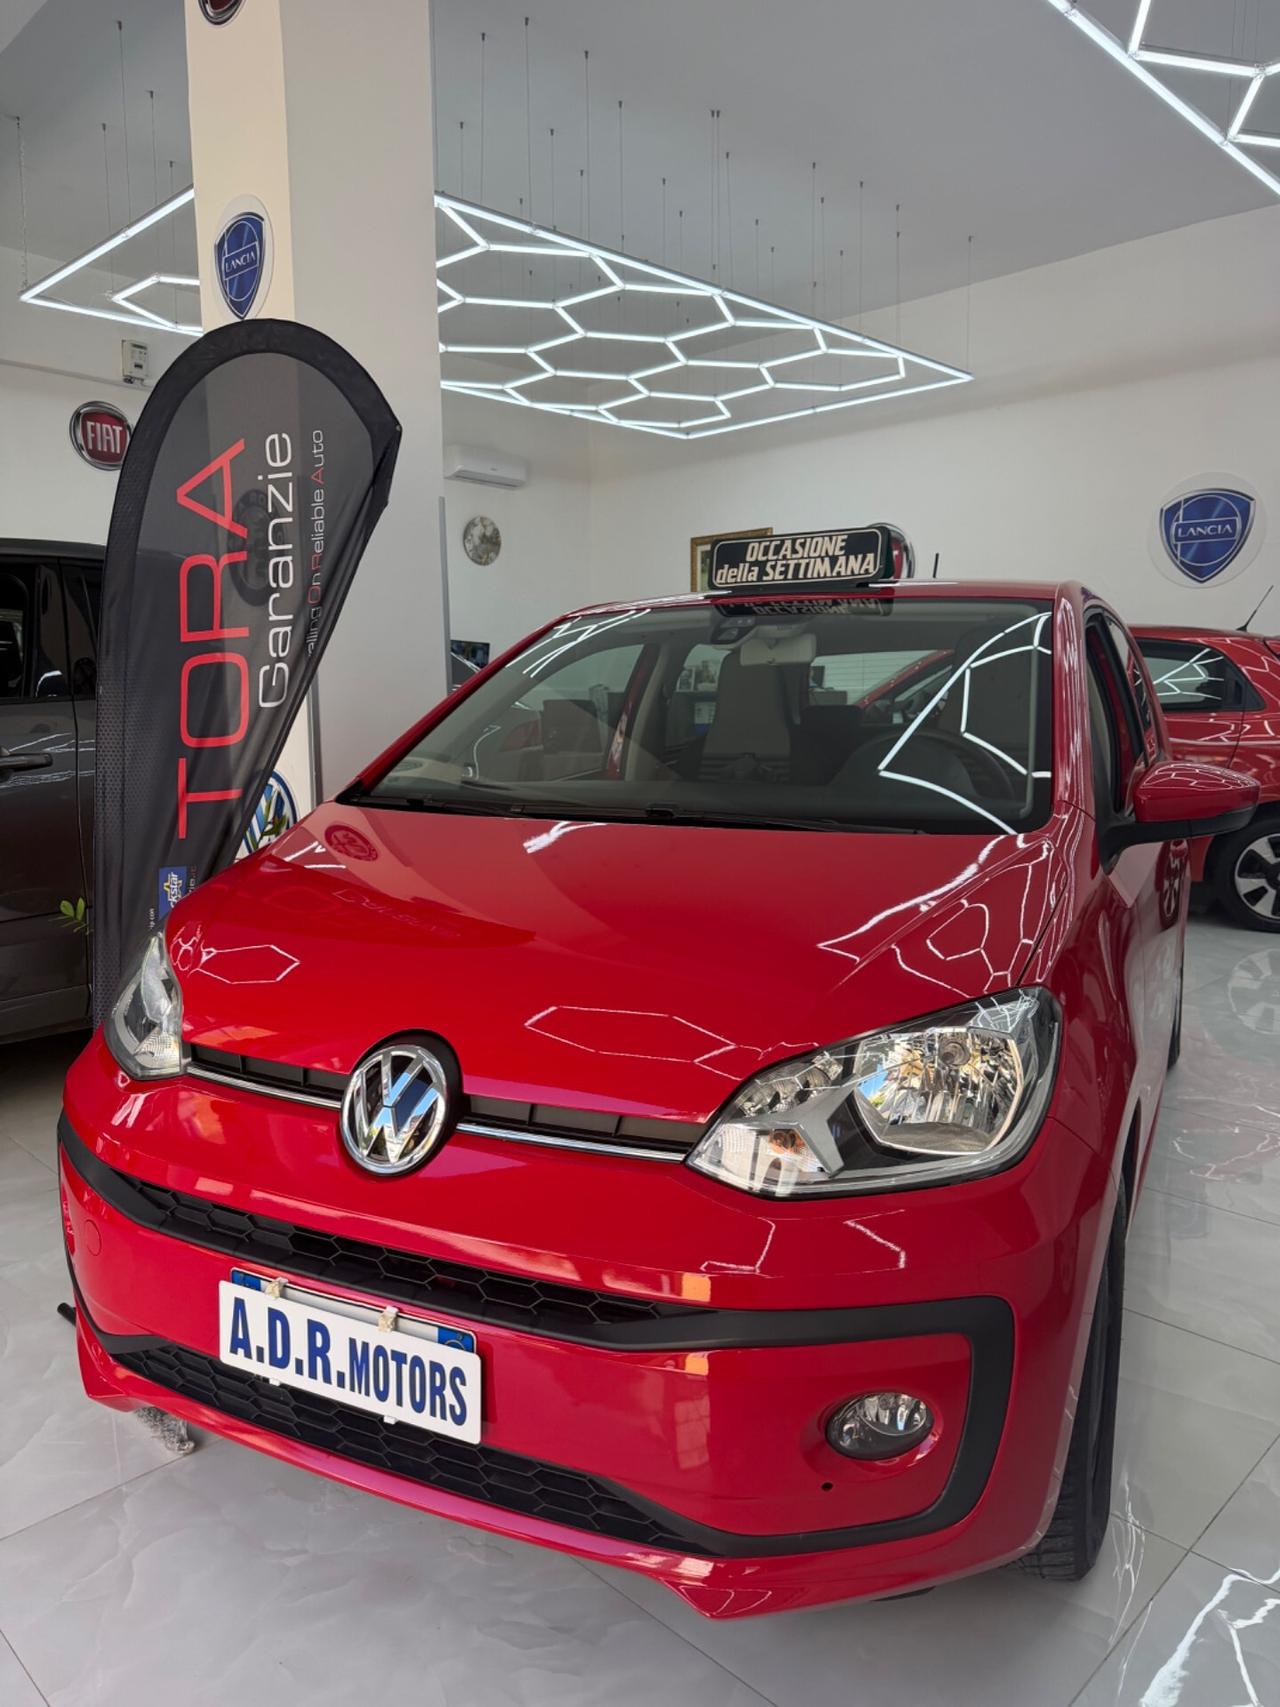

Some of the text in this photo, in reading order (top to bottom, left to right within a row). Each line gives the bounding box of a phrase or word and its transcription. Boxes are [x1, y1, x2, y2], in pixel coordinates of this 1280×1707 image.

[225, 250, 256, 273] LANCIA
[86, 421, 123, 454] FIAT
[310, 430, 325, 486] Auto
[310, 489, 325, 571] Reliable
[1177, 524, 1233, 538] LANCIA
[745, 535, 849, 562] OCCASIONE
[257, 432, 294, 708] Garanzie
[715, 553, 876, 584] della SETTIMANA
[307, 572, 321, 605] On
[176, 438, 250, 840] TORA
